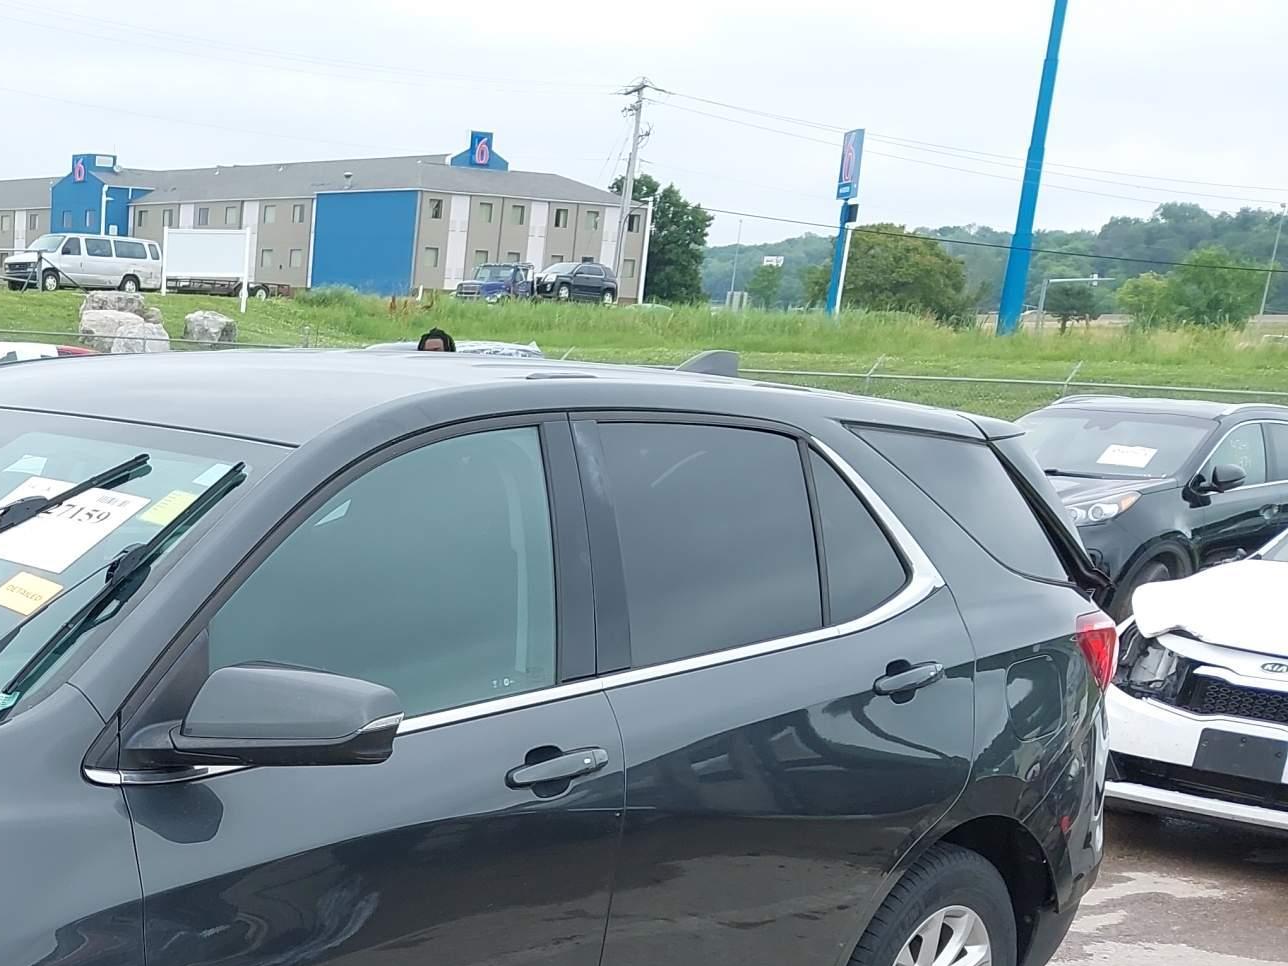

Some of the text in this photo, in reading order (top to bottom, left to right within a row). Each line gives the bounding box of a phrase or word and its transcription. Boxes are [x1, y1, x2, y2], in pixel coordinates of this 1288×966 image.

[475, 137, 489, 165] 6
[75, 158, 85, 182] 6
[1264, 664, 1288, 672] KIA
